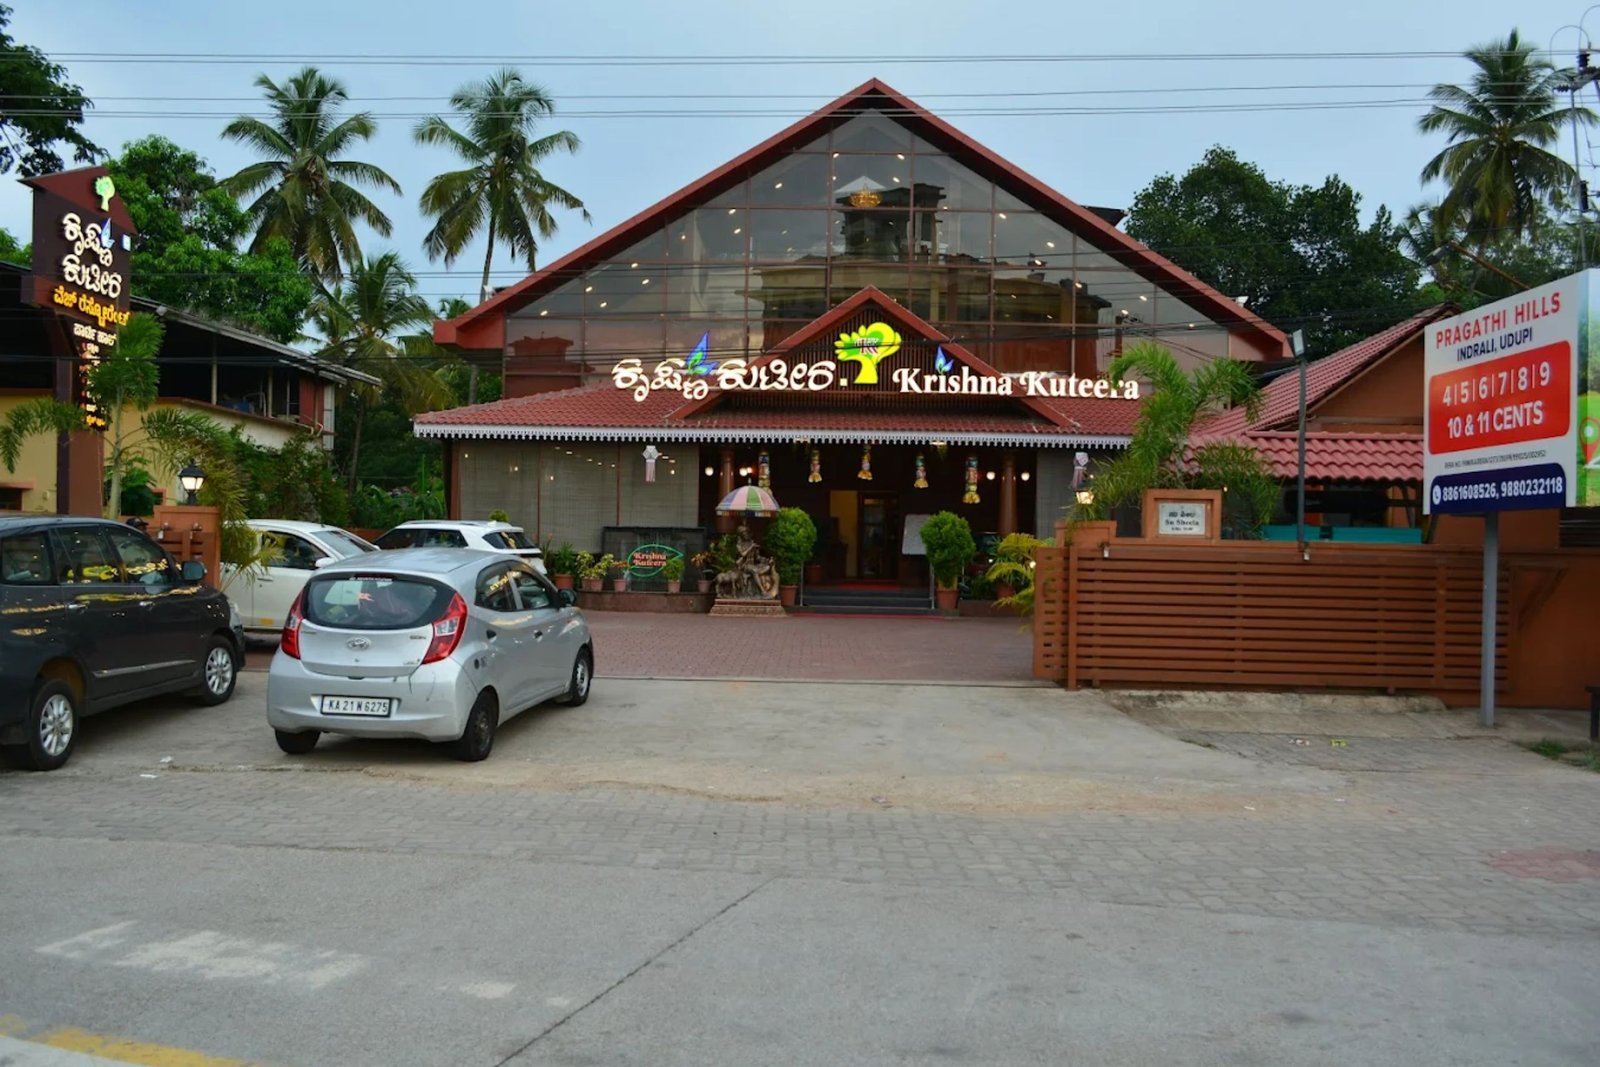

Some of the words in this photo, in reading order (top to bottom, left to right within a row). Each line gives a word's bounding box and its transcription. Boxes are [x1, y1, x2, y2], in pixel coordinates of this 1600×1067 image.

[62, 212, 113, 267] ಕೃಷ್ಣ
[62, 254, 122, 298] ಕುಟೀರ
[1436, 309, 1507, 349] PRAGATHI
[1515, 292, 1561, 325] HILLS
[1457, 338, 1497, 362] INDRALI,
[1500, 327, 1533, 350] UDUPI
[611, 358, 709, 402] ಕೃಷ್ಣ
[717, 358, 836, 391] ಕುಟೀರ
[892, 366, 1013, 395] Krishna
[1020, 371, 1140, 400] Kuteera
[1448, 416, 1461, 439] 10
[1465, 414, 1474, 436] &
[1477, 411, 1489, 434] 11
[1493, 400, 1544, 431] CENTS
[1442, 483, 1500, 502] 8861608526,
[1501, 476, 1563, 497] 9880232118
[329, 700, 340, 711] KA
[343, 701, 354, 711] 21
[364, 701, 388, 713] 6275
